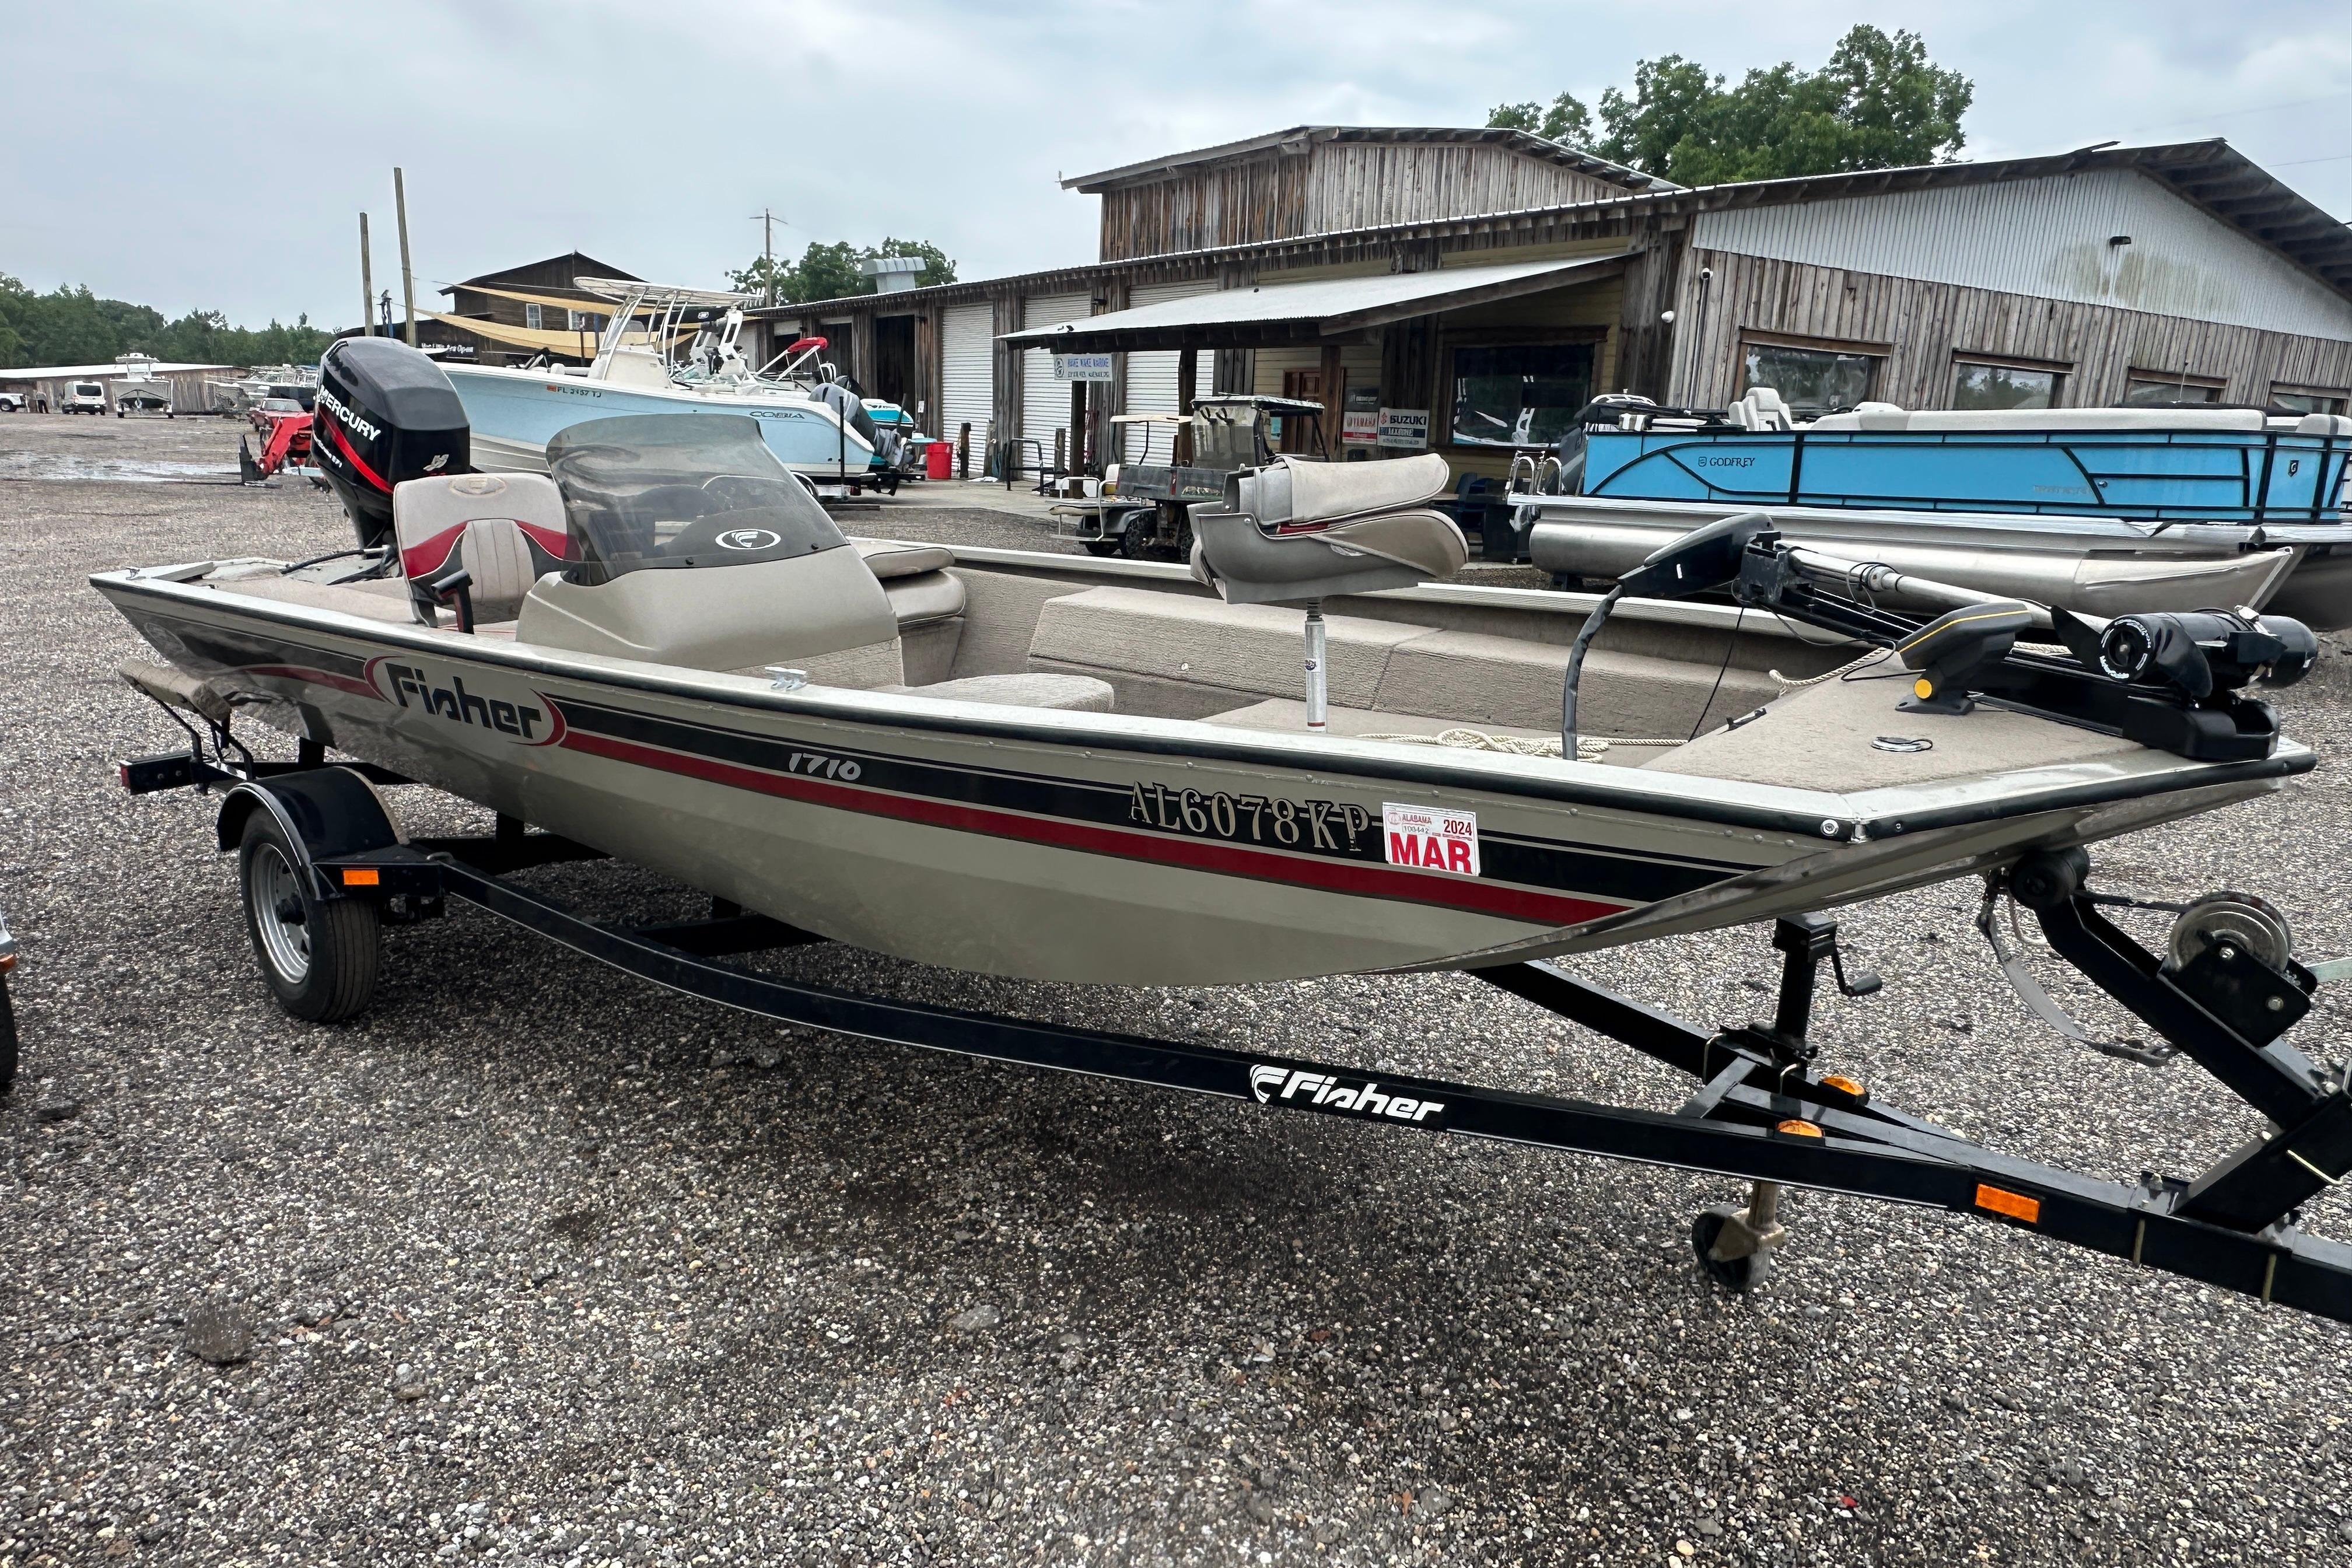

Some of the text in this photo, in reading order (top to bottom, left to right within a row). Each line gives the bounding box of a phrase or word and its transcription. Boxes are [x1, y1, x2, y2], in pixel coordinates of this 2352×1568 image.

[314, 385, 381, 441] MERCURY
[1390, 415, 1426, 425] SUZUKI
[1710, 457, 1755, 467] GODFREY
[385, 663, 542, 739] Fisher
[789, 752, 862, 780] 1710
[1402, 813, 1472, 836] ALABAMA 2024
[1390, 832, 1472, 874] MAR
[1280, 1070, 1445, 1121] Fisher
